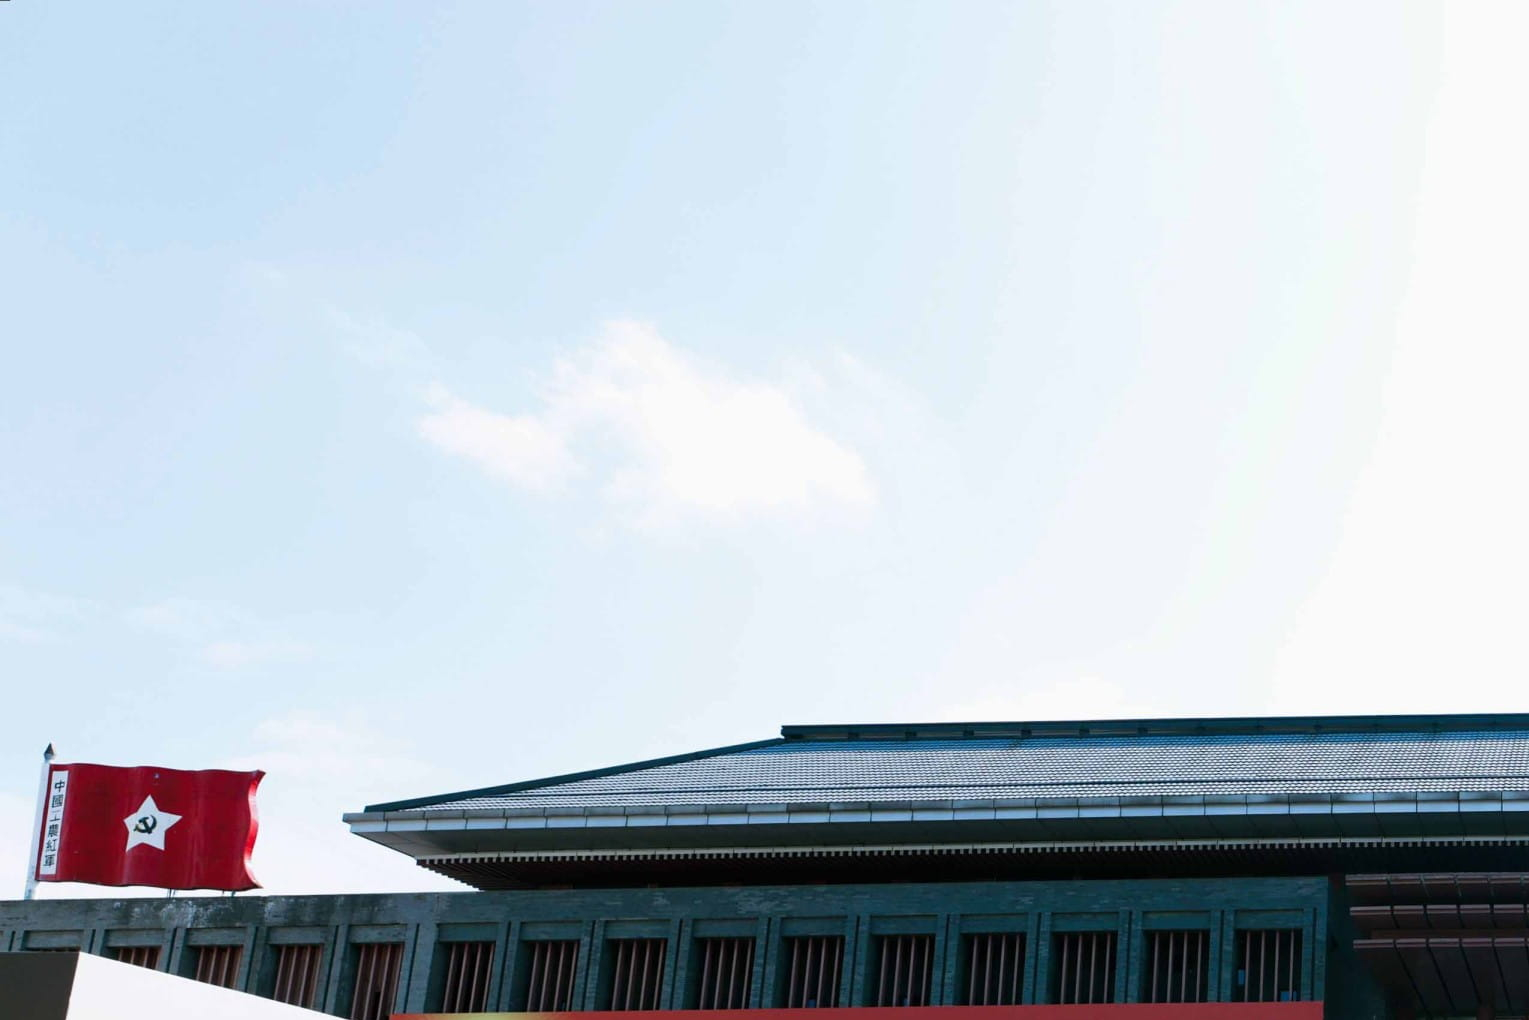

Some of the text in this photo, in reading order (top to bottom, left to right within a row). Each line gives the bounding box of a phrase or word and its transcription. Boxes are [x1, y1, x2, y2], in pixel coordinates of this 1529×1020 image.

[43, 780, 65, 867] 中國工農紅軍
